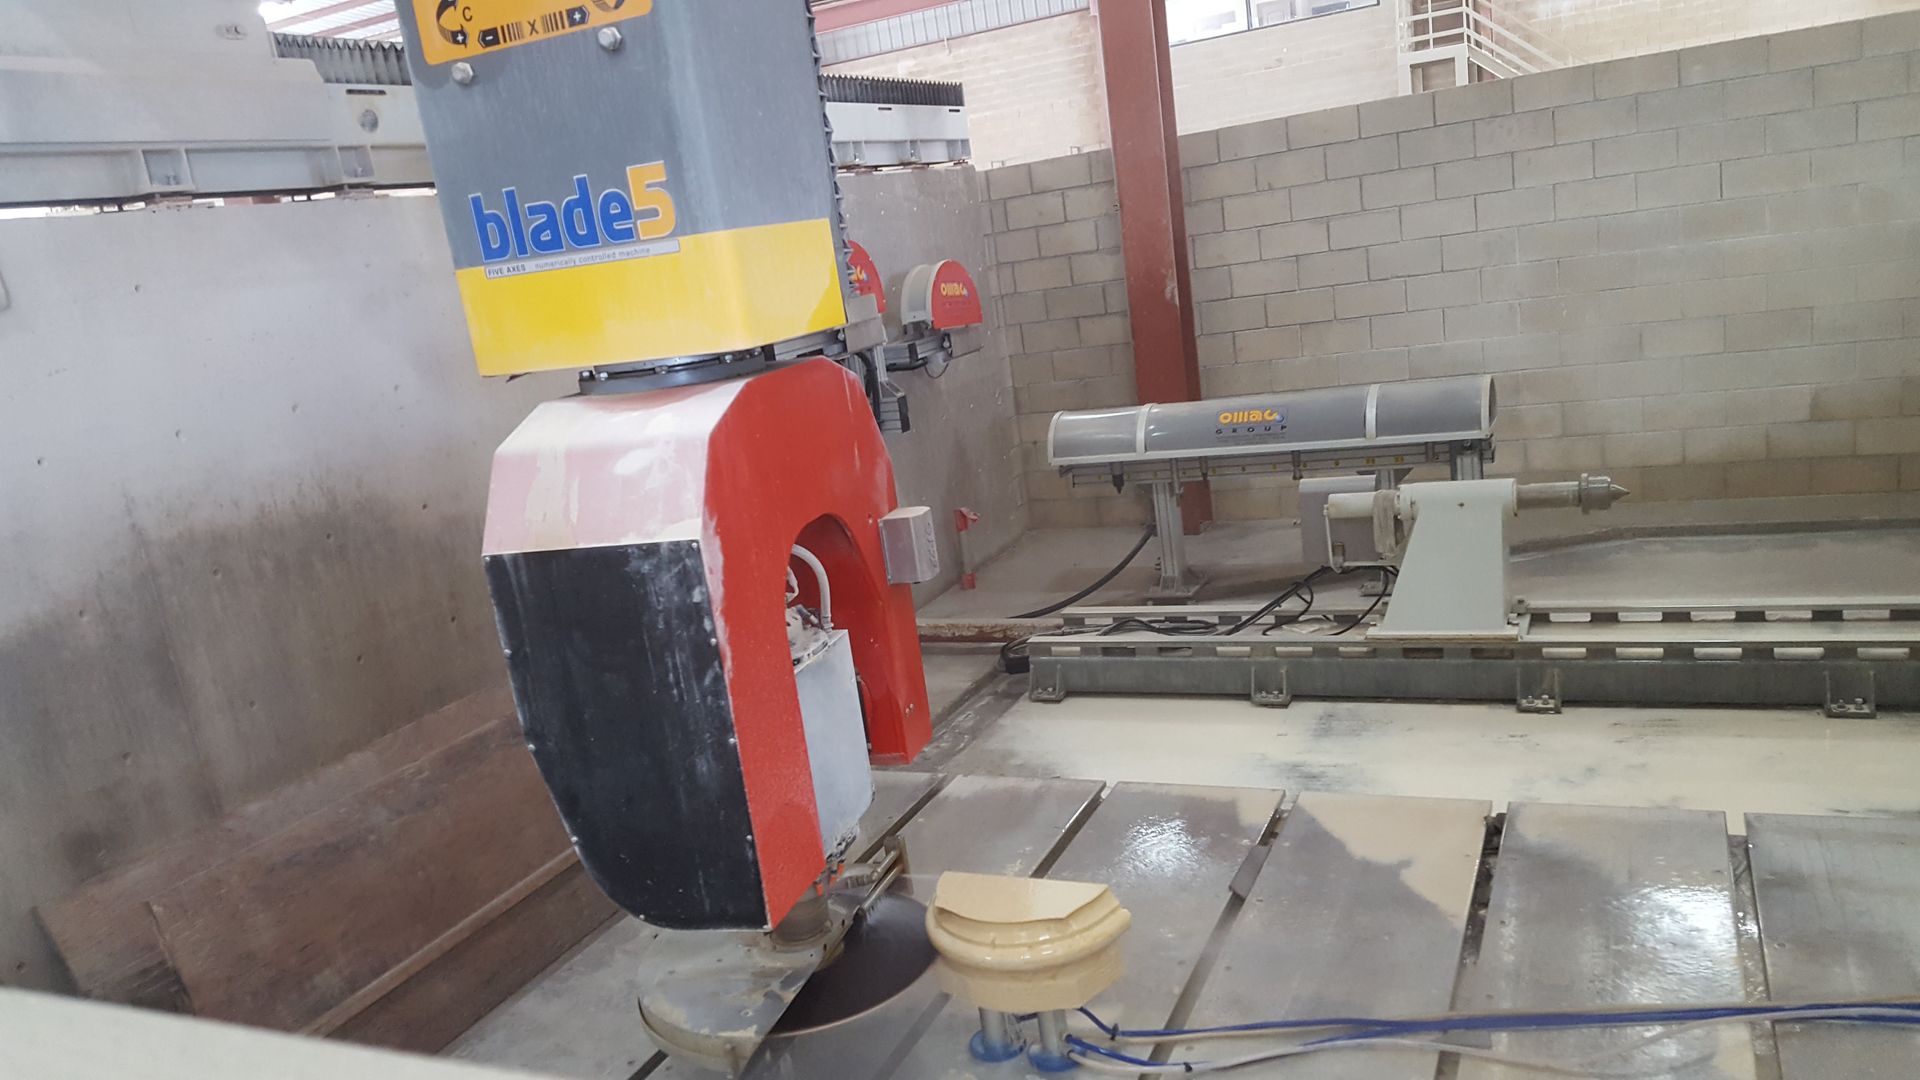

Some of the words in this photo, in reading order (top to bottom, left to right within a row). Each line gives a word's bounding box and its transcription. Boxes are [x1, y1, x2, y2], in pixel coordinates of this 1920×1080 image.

[462, 6, 473, 22] C
[527, 20, 539, 36] X
[487, 267, 504, 278] FIVE
[506, 263, 526, 274] AXES
[534, 257, 576, 269] numerically
[578, 251, 616, 264] controlled
[618, 246, 651, 257] machine
